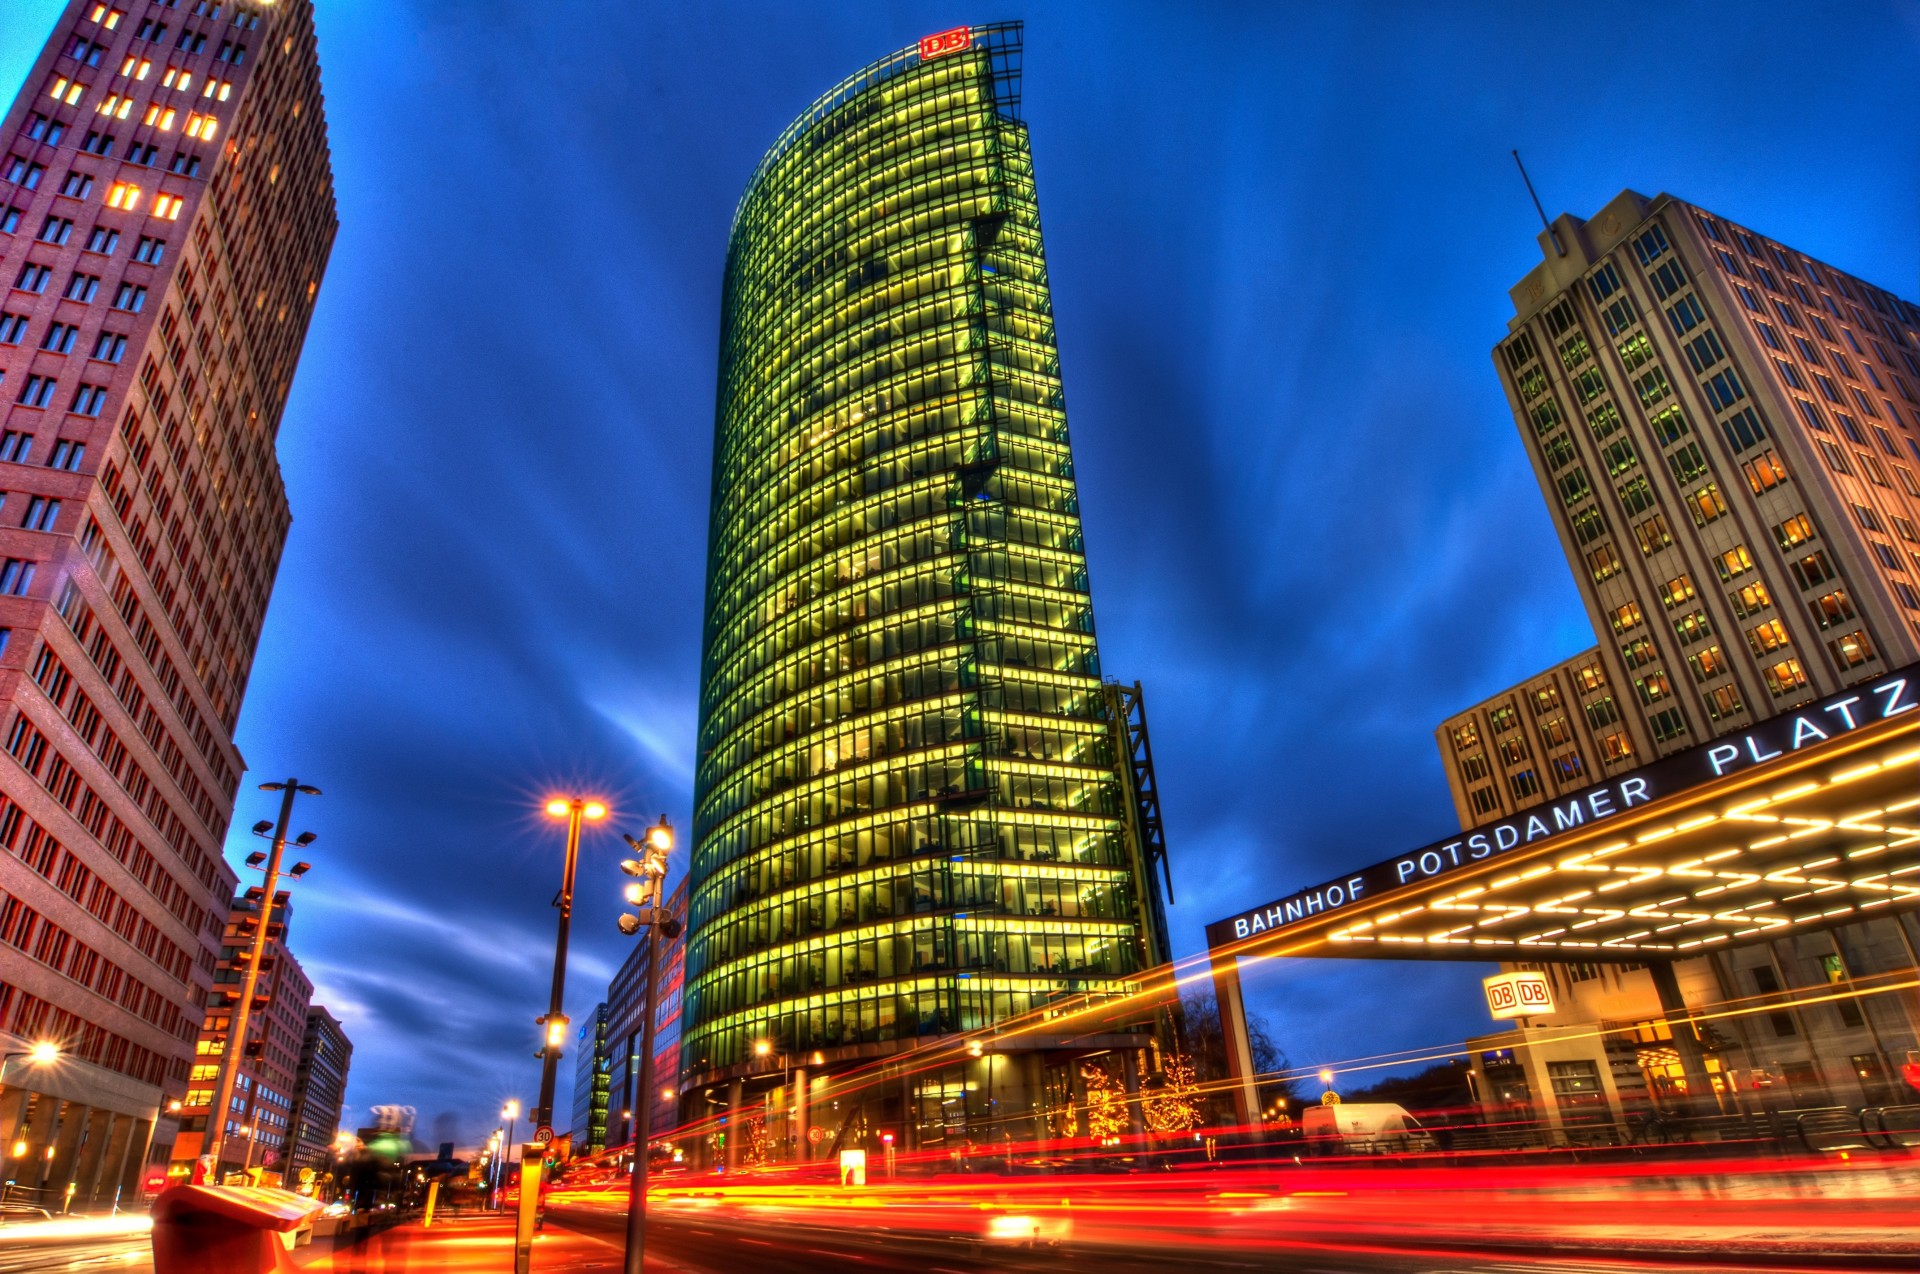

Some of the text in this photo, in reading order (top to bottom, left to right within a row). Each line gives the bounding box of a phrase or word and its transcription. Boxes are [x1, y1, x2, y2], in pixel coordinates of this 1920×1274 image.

[924, 29, 966, 57] DB
[1235, 678, 1919, 939] BAHNHOF POTSDAMER PLATZ
[1490, 986, 1513, 1006] DB
[1520, 983, 1545, 1002] DB
[538, 1131, 550, 1142] 30
